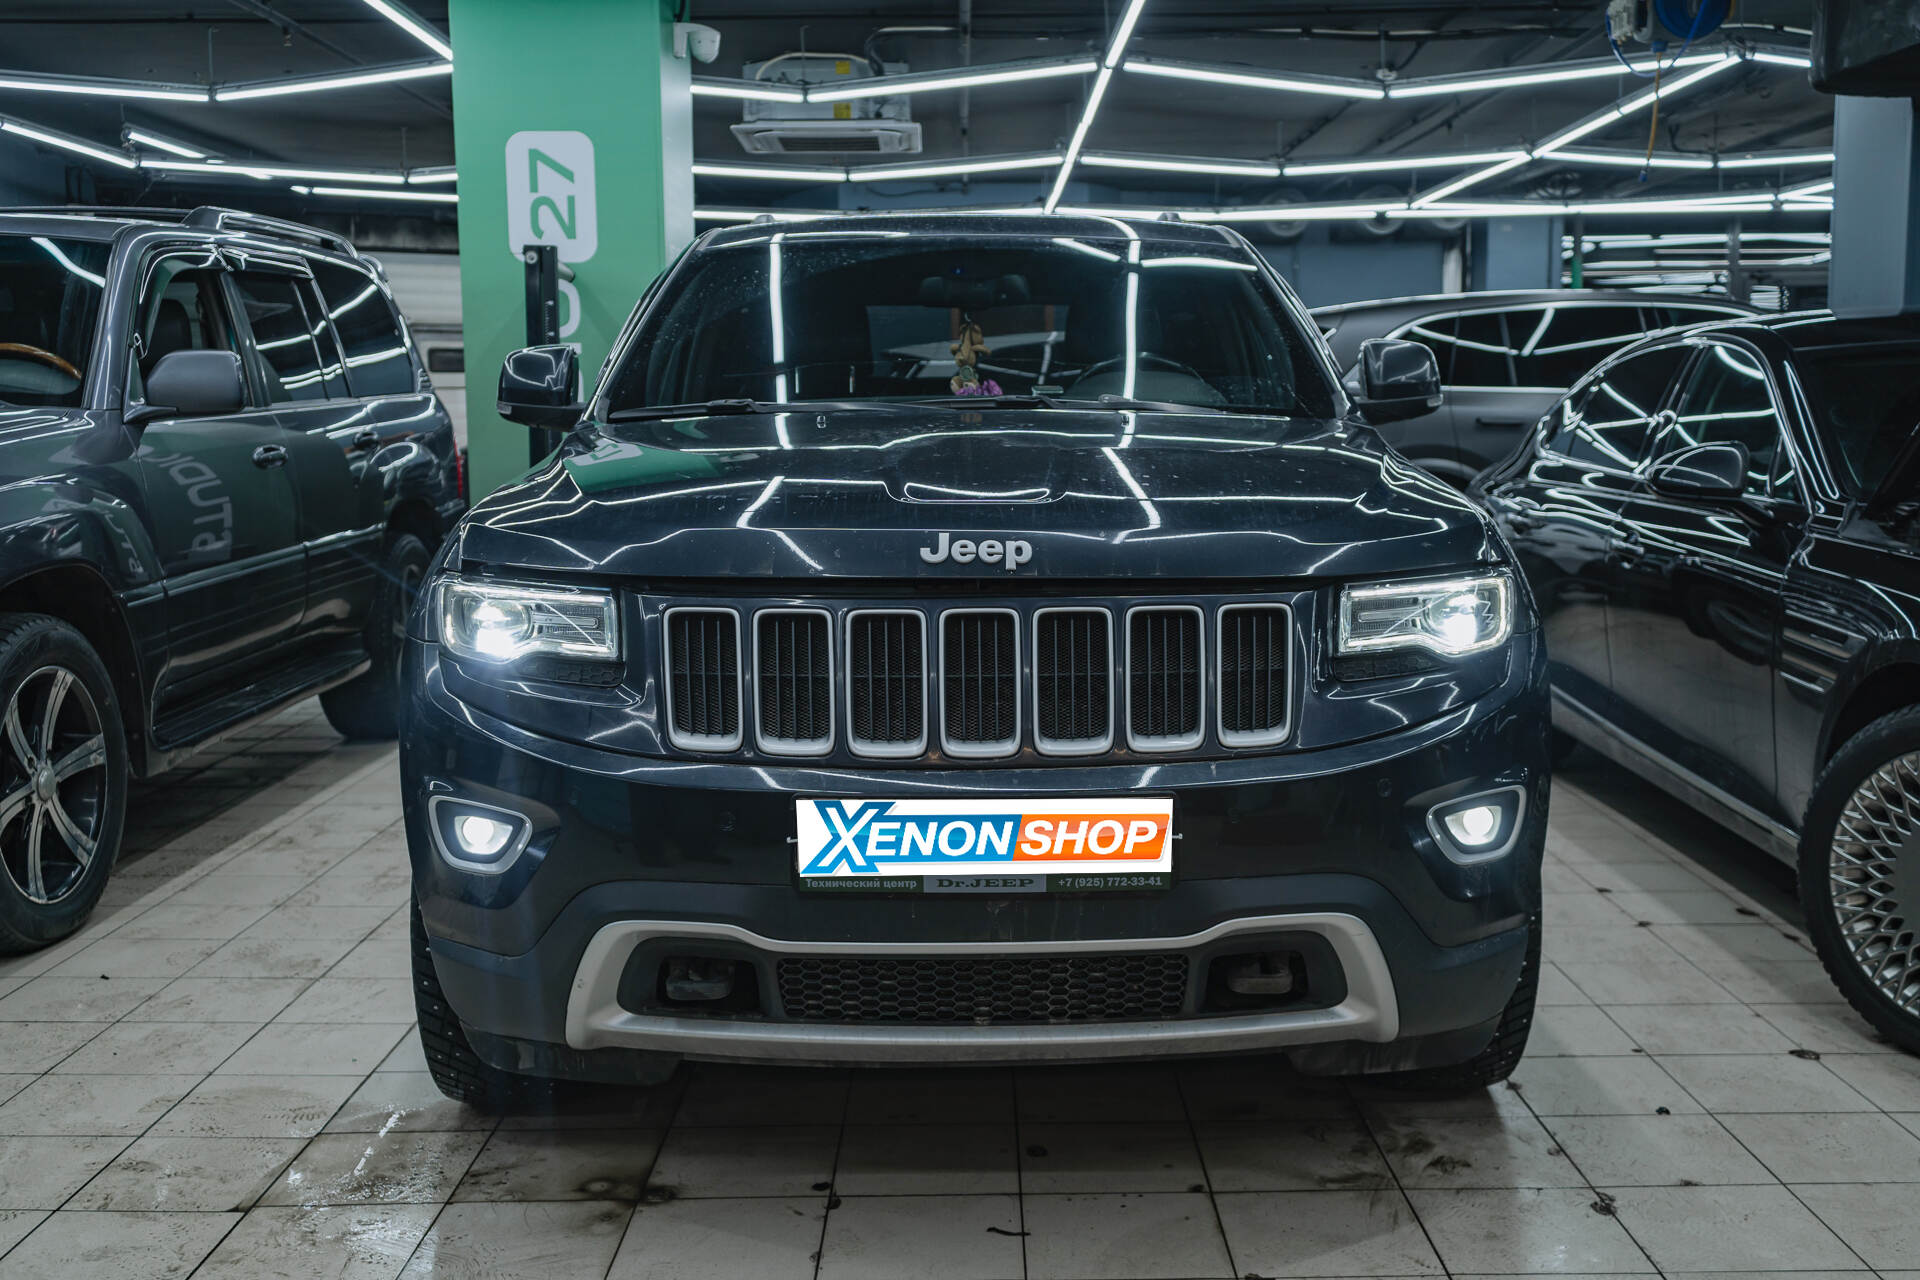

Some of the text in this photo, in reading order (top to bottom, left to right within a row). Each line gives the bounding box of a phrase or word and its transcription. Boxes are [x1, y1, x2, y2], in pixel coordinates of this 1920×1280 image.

[527, 147, 577, 240] 27
[919, 532, 1033, 571] Jeep
[805, 877, 918, 890] Технический центр
[935, 877, 1035, 889] Dr.JEEP
[1058, 875, 1163, 889] +7 (925) 772-33-41
